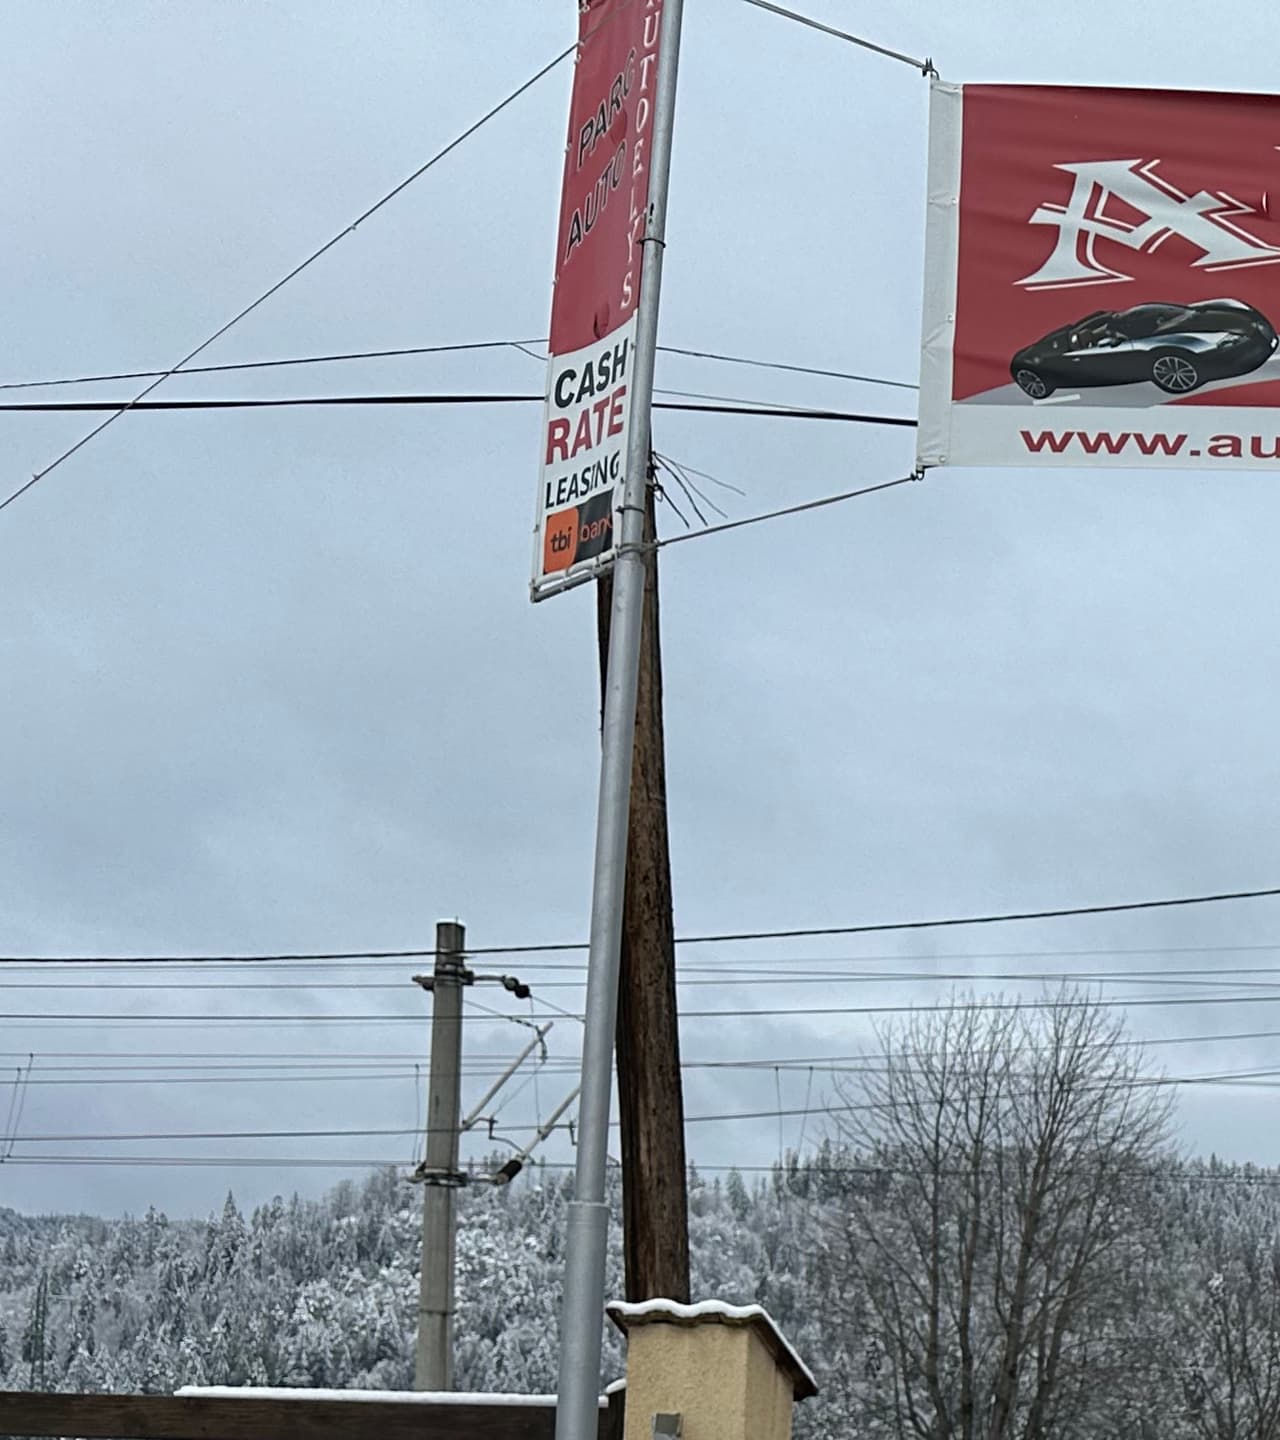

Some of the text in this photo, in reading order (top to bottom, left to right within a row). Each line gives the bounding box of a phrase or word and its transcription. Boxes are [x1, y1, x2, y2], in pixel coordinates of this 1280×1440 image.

[577, 47, 636, 172] PARC
[620, 0, 661, 310] UTOELYS
[564, 139, 627, 265] AUTO
[555, 338, 628, 409] CASH
[545, 384, 627, 466] RATE
[545, 450, 620, 509] LEASING
[550, 527, 572, 553] tbi
